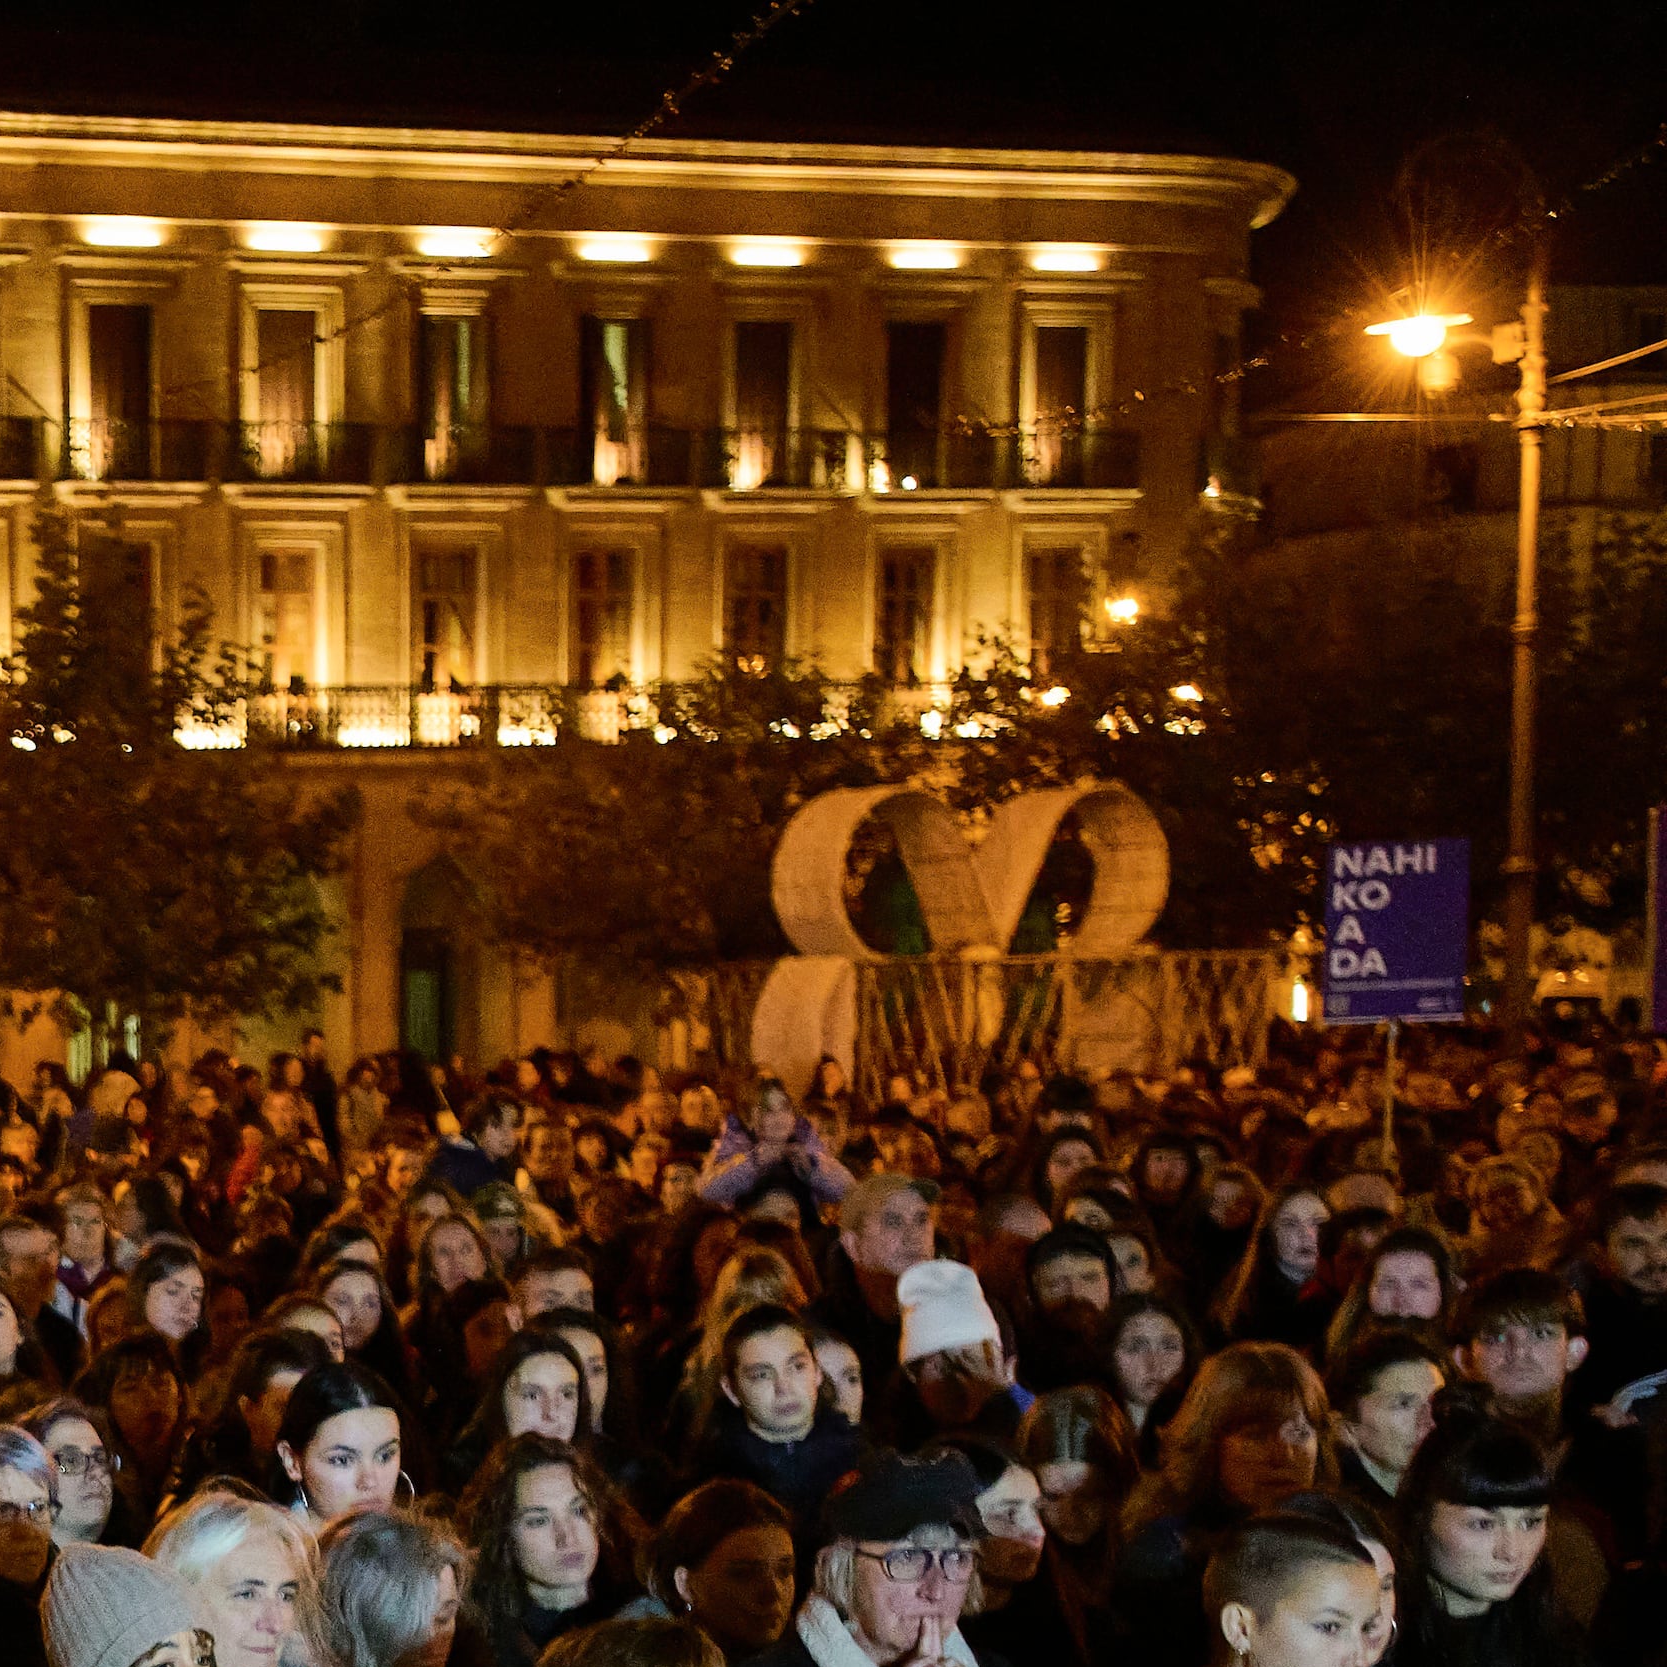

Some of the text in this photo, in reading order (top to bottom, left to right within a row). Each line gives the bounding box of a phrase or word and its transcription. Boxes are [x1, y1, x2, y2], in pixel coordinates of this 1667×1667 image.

[1332, 844, 1438, 878] NAHI
[1332, 880, 1392, 912] KO
[1333, 915, 1366, 946] A
[1329, 948, 1388, 979] DA
